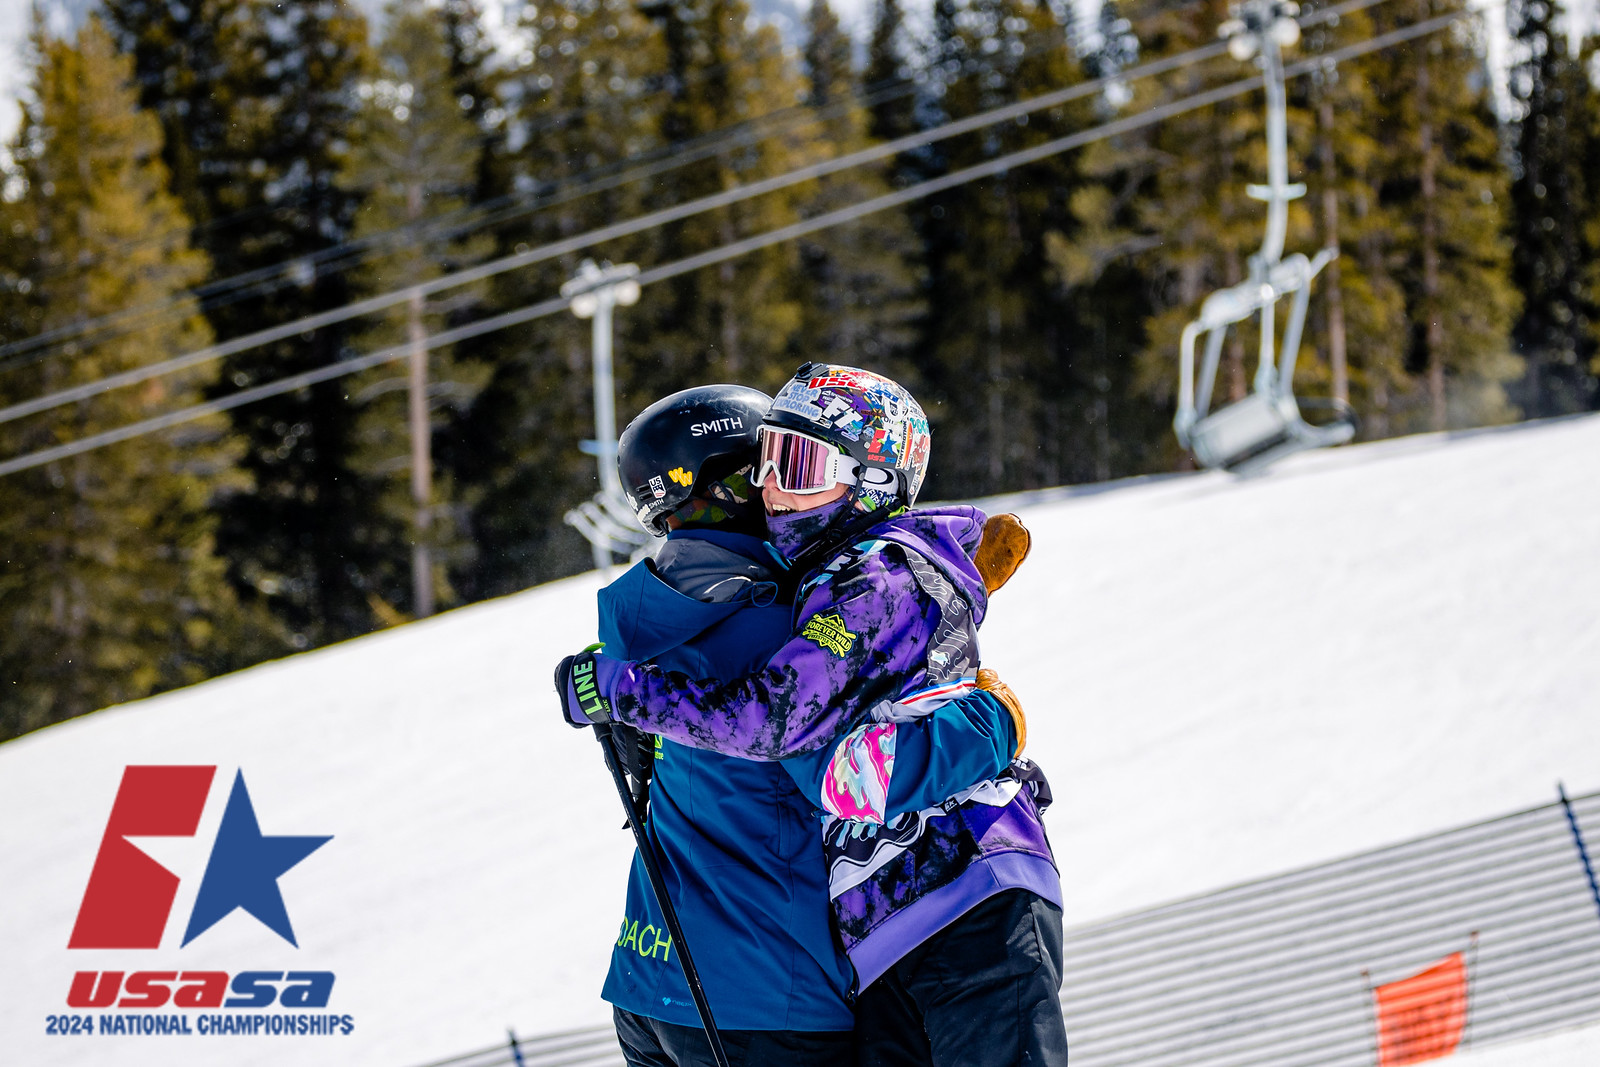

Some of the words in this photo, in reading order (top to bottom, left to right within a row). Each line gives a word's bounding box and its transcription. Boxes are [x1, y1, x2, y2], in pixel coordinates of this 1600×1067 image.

[789, 392, 810, 403] STOP
[793, 384, 818, 397] NEVER
[690, 416, 743, 437] SMITH
[650, 477, 662, 487] US
[806, 621, 836, 638] FOREVER
[835, 633, 852, 650] WILD
[574, 660, 603, 715] LINE
[617, 916, 672, 962] OACH
